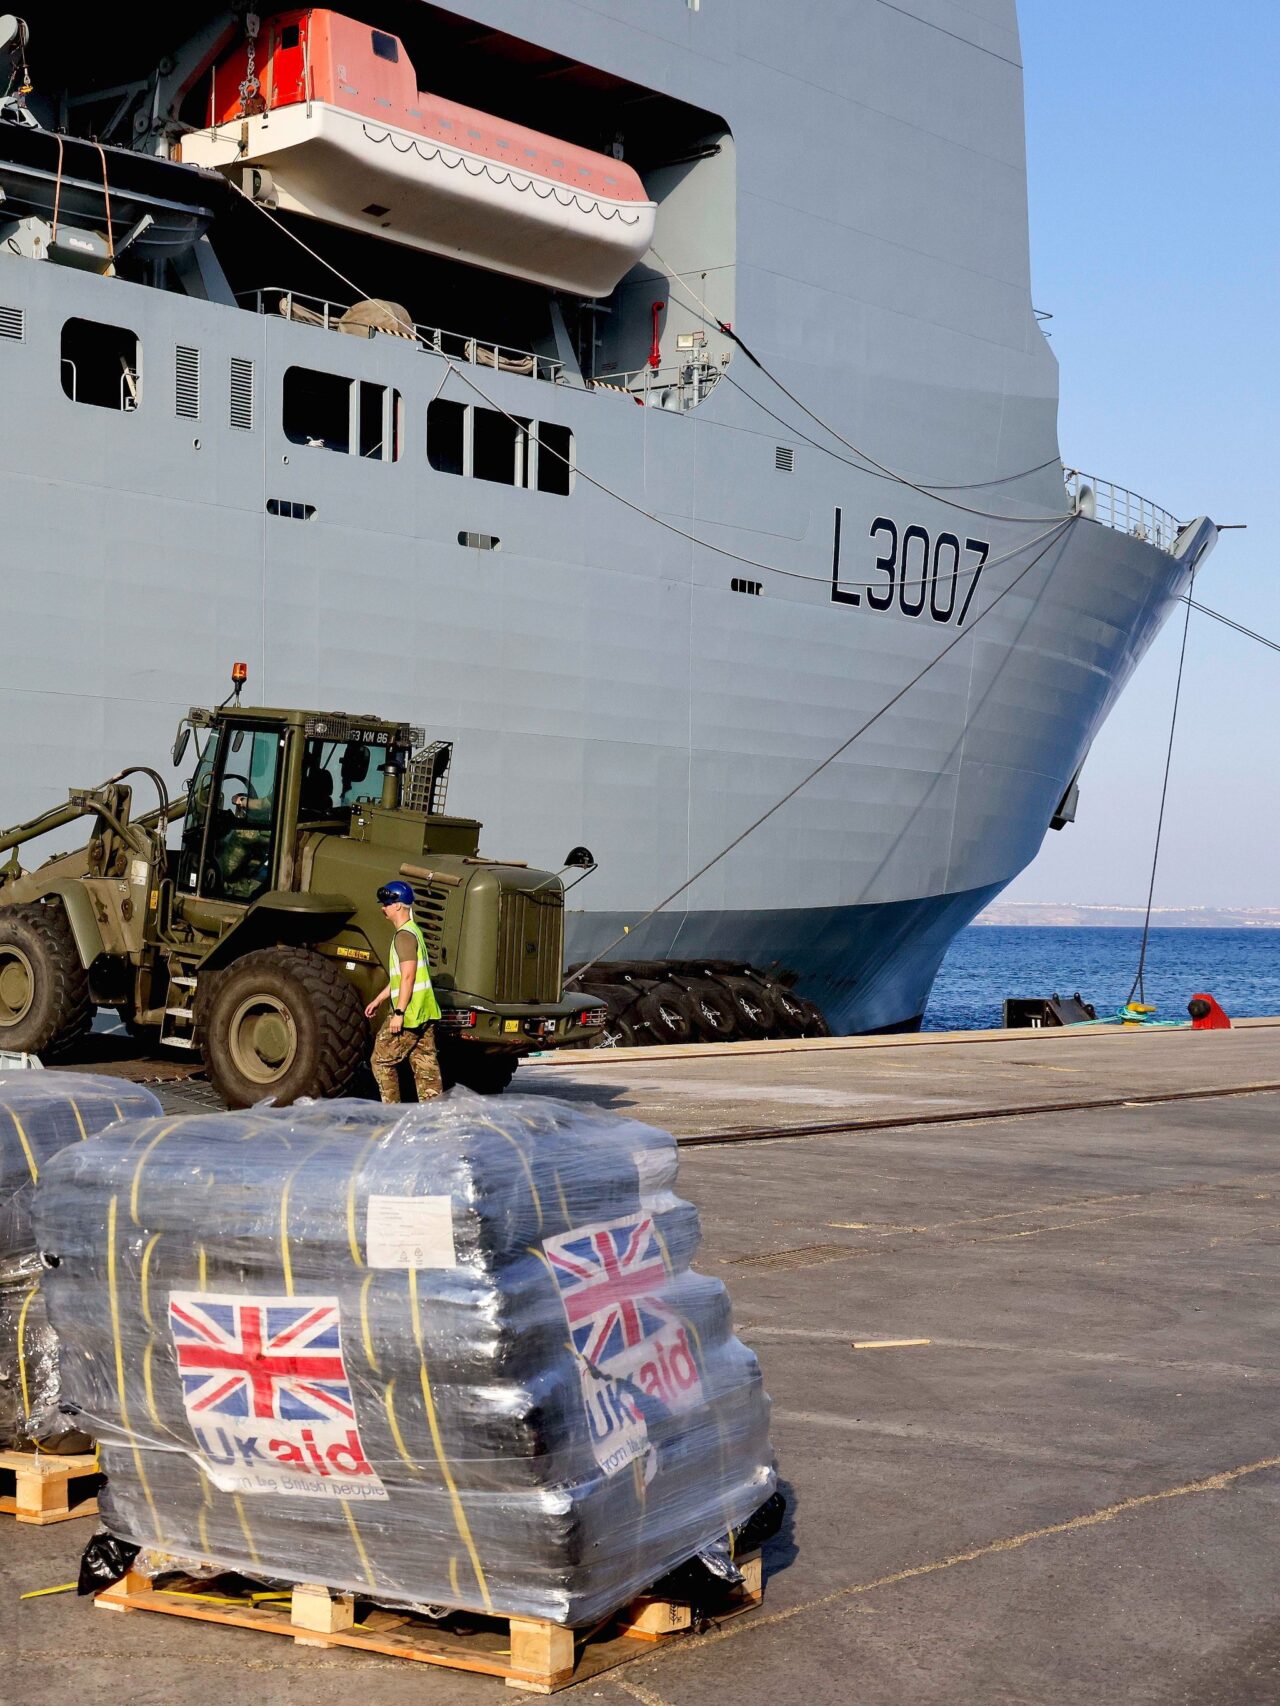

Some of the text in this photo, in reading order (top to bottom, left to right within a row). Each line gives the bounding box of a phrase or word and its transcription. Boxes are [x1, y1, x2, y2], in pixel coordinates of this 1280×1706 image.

[830, 506, 991, 627] L3007
[362, 731, 375, 742] KM
[377, 732, 388, 743] 86
[332, 1482, 385, 1498] people
